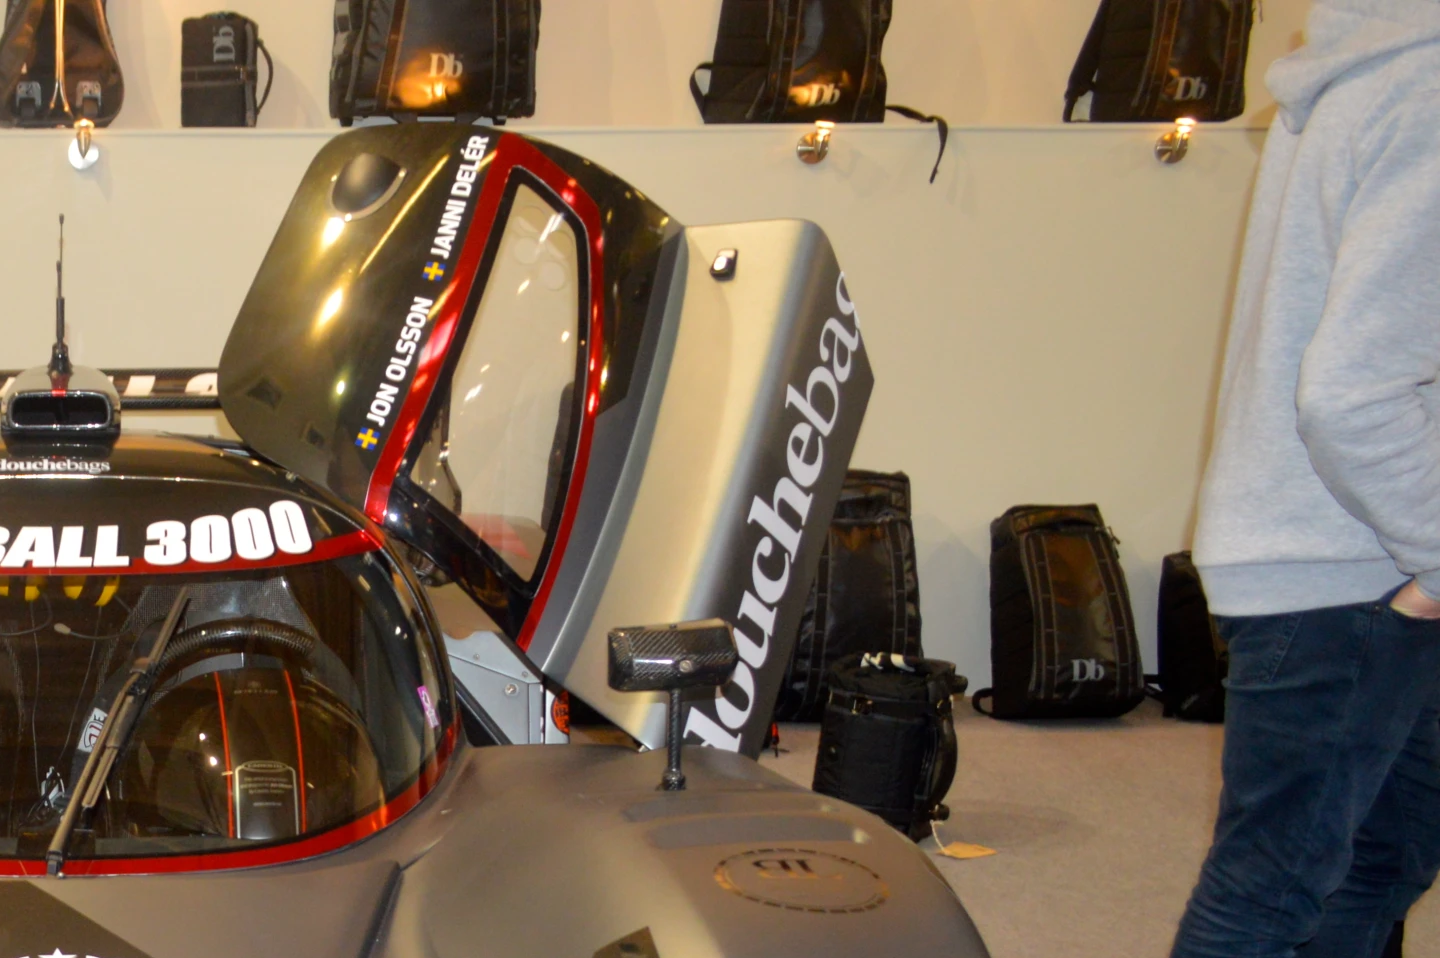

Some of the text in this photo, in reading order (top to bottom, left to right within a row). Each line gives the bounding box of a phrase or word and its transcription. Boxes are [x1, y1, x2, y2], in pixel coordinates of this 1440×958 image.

[212, 25, 234, 62] Db
[428, 52, 463, 78] Db
[808, 82, 841, 107] Db
[1173, 75, 1207, 101] Db
[430, 134, 490, 260] JANNI DELÉR
[366, 296, 433, 427] JON OLSSON
[143, 499, 314, 564] 3000
[1072, 658, 1105, 682] Db
